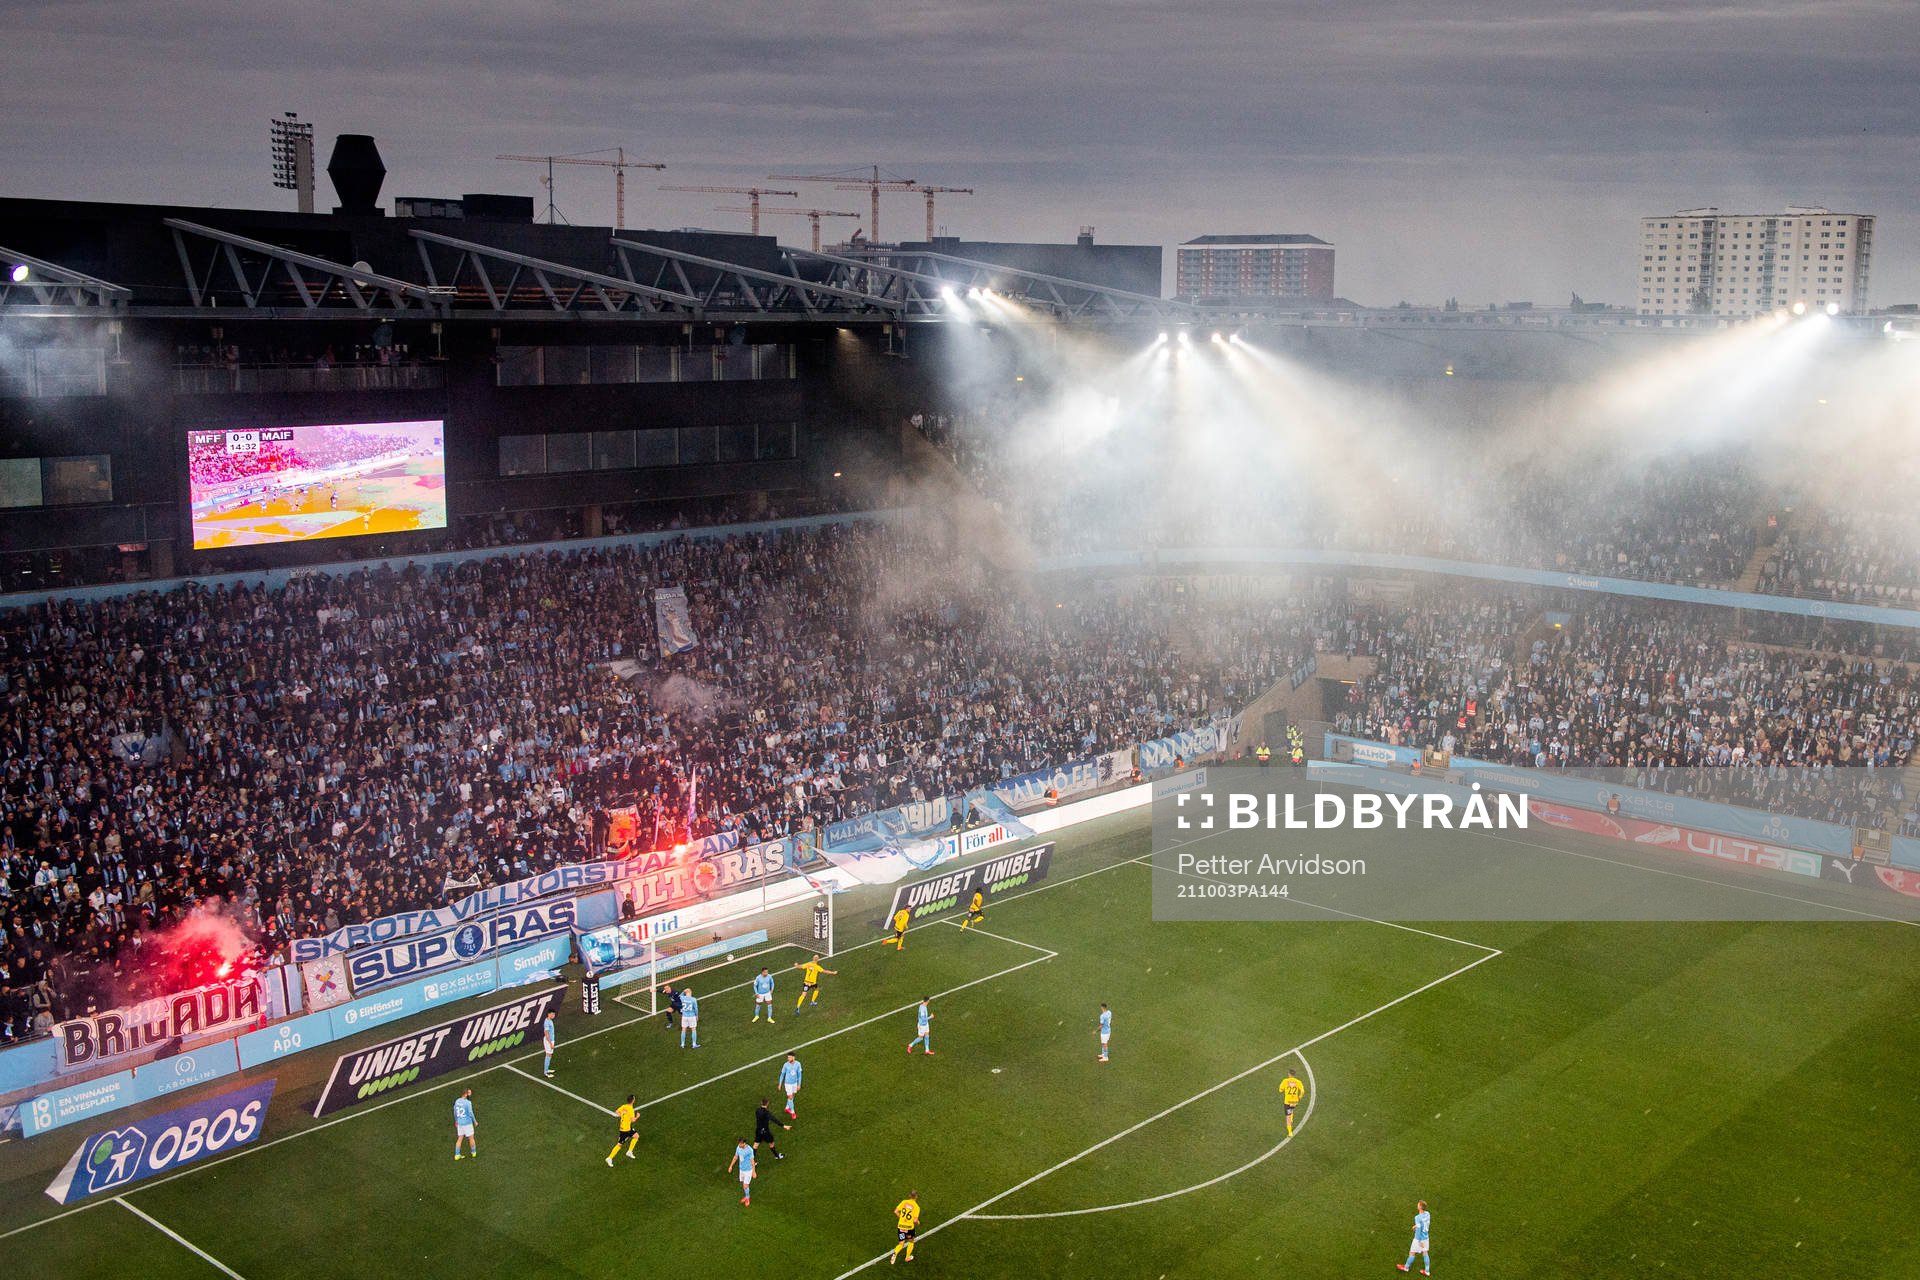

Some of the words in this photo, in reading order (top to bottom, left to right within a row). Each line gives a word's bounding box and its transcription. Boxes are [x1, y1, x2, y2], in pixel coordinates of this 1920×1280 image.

[195, 435, 221, 444] MFF
[230, 443, 257, 451] 14:32
[233, 434, 252, 442] 0-0
[262, 431, 292, 440] MAIF
[966, 833, 986, 850] För
[988, 826, 1003, 843] all
[1687, 832, 1817, 876] ULTRA
[907, 870, 976, 908] UNIBET
[983, 848, 1046, 885] UNIBET
[295, 911, 442, 962] SKROTA
[513, 949, 556, 972] Simplify
[440, 969, 492, 991] exakta
[359, 998, 404, 1018] Elitfönster
[591, 982, 599, 1013] SELECT
[348, 1028, 452, 1085] UNIBET
[460, 994, 554, 1049] UNIBET
[158, 1069, 217, 1093] CABONLINE
[1287, 1086, 1298, 1095] 22
[59, 1097, 72, 1107] EN
[74, 1083, 121, 1102] VINNANDE
[60, 1094, 116, 1117] MÖTESPLATS
[149, 1101, 262, 1170] OBOS
[900, 1207, 912, 1220] 96
